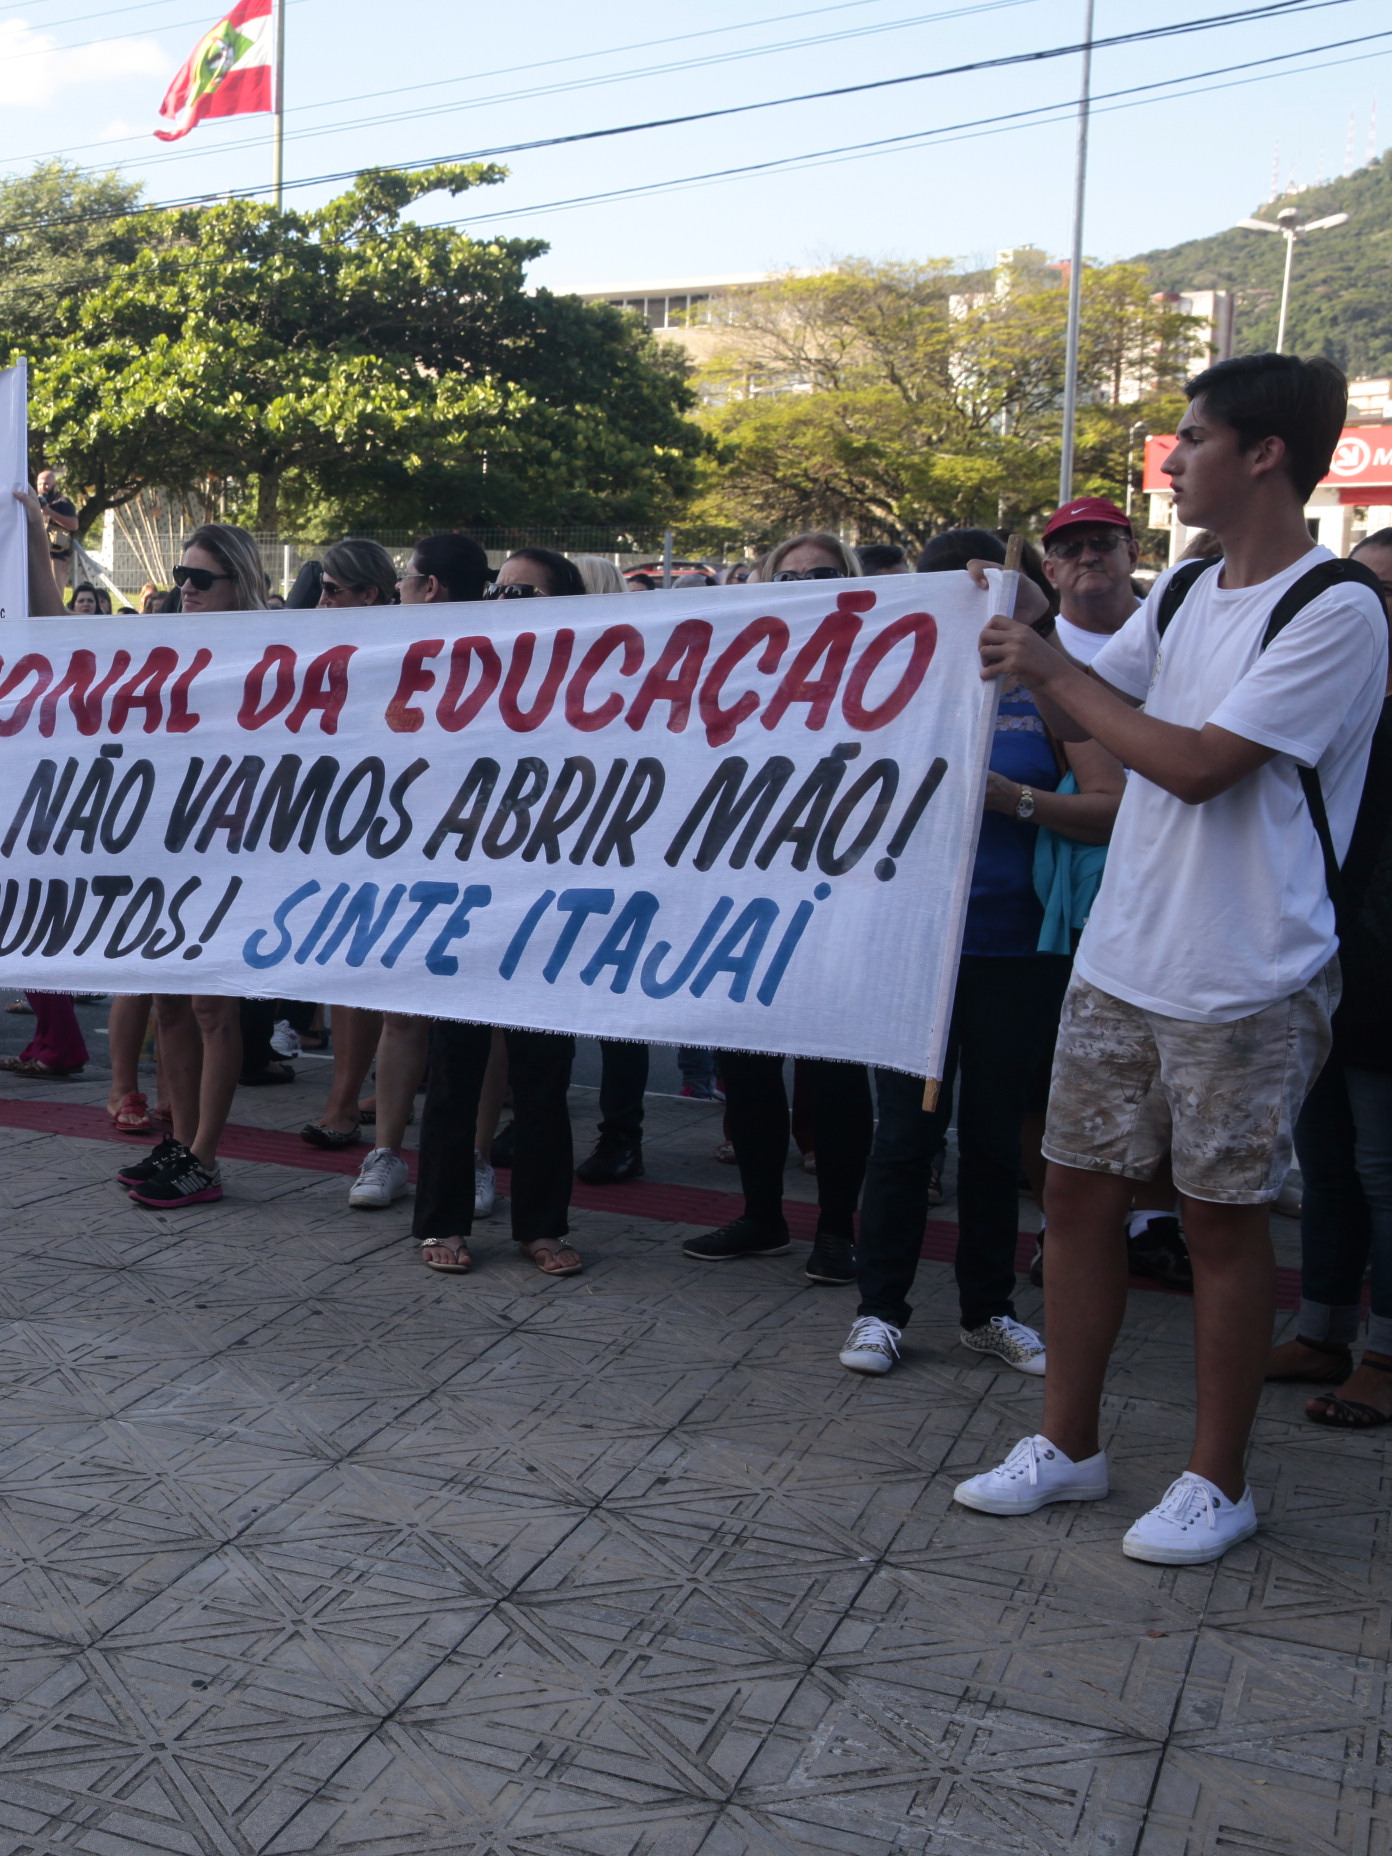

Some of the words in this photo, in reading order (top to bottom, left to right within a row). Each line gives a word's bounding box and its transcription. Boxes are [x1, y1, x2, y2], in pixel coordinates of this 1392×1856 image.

[236, 644, 359, 735] DA
[384, 590, 938, 748] EDUCAÇÃO
[0, 743, 156, 859] NÃO
[163, 753, 430, 860] VAMOS
[422, 756, 666, 868] ABRIR
[664, 742, 949, 882] MÃO!
[242, 878, 492, 976] SINTE
